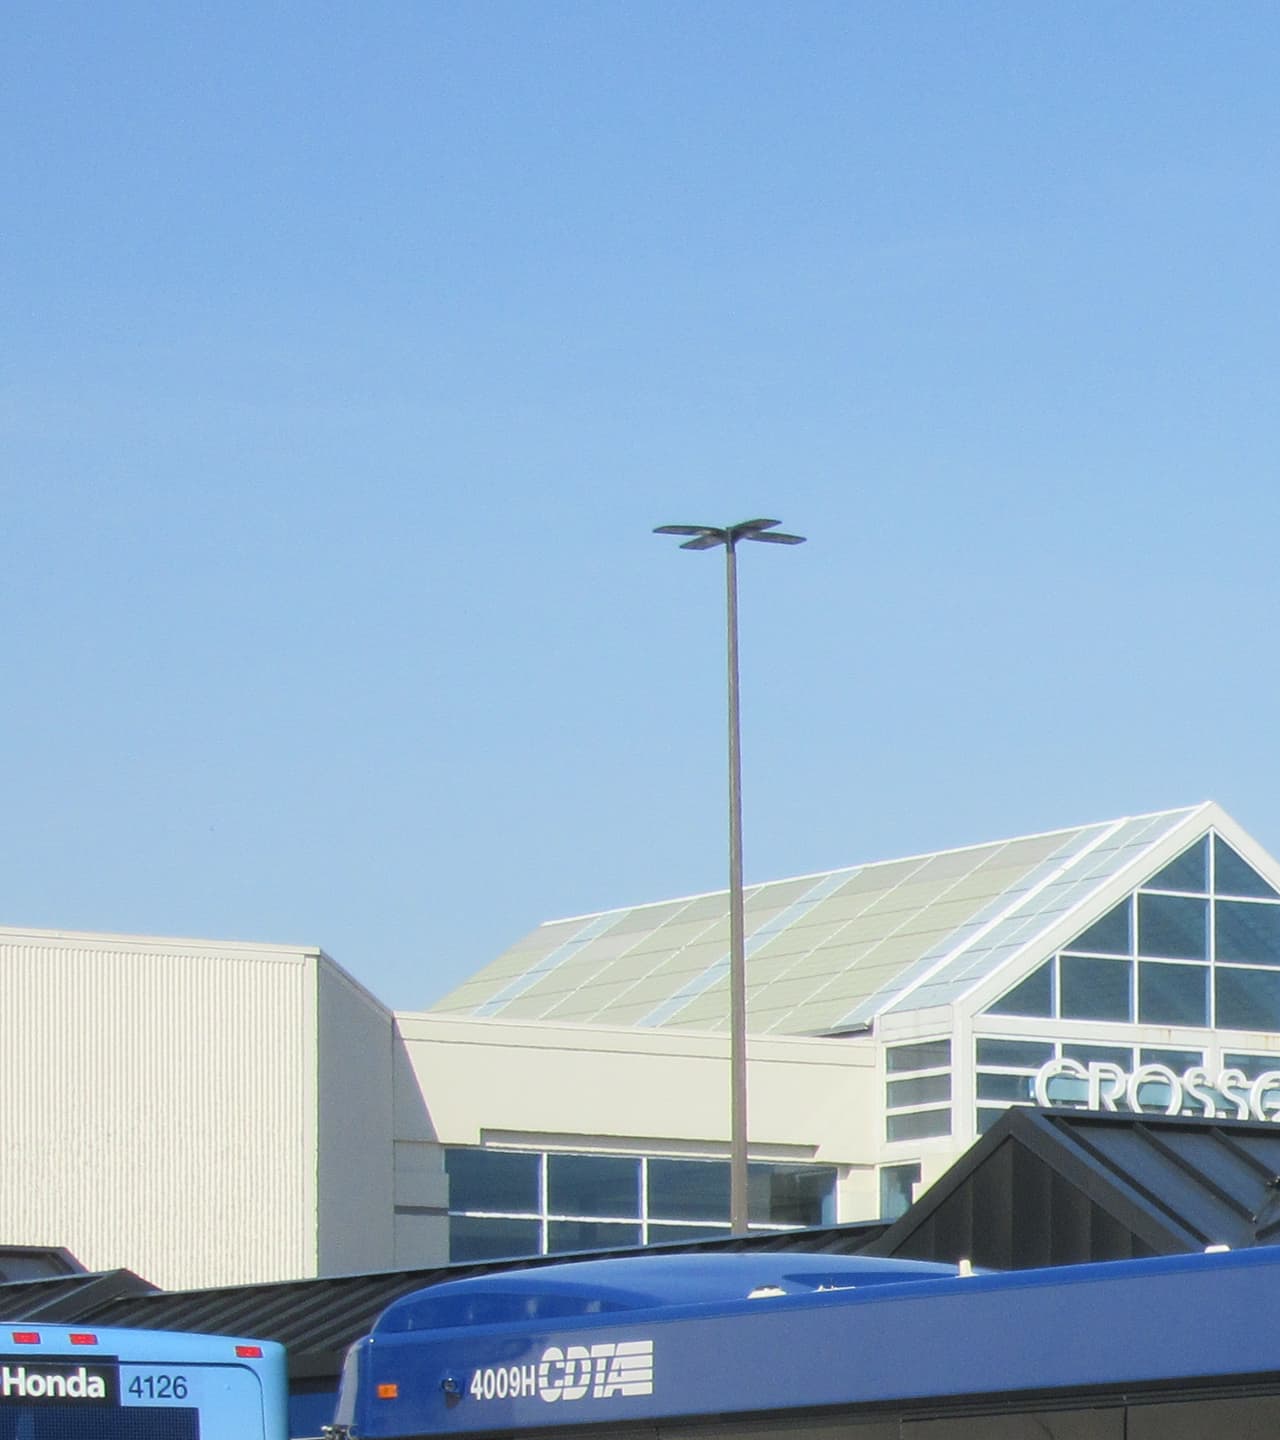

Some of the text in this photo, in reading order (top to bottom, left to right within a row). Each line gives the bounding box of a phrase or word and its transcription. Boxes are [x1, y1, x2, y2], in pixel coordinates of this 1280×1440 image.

[2, 1366, 106, 1398] Honda
[128, 1374, 188, 1399] 4126
[470, 1365, 535, 1401] 4009H
[538, 1340, 653, 1402] CDTA
